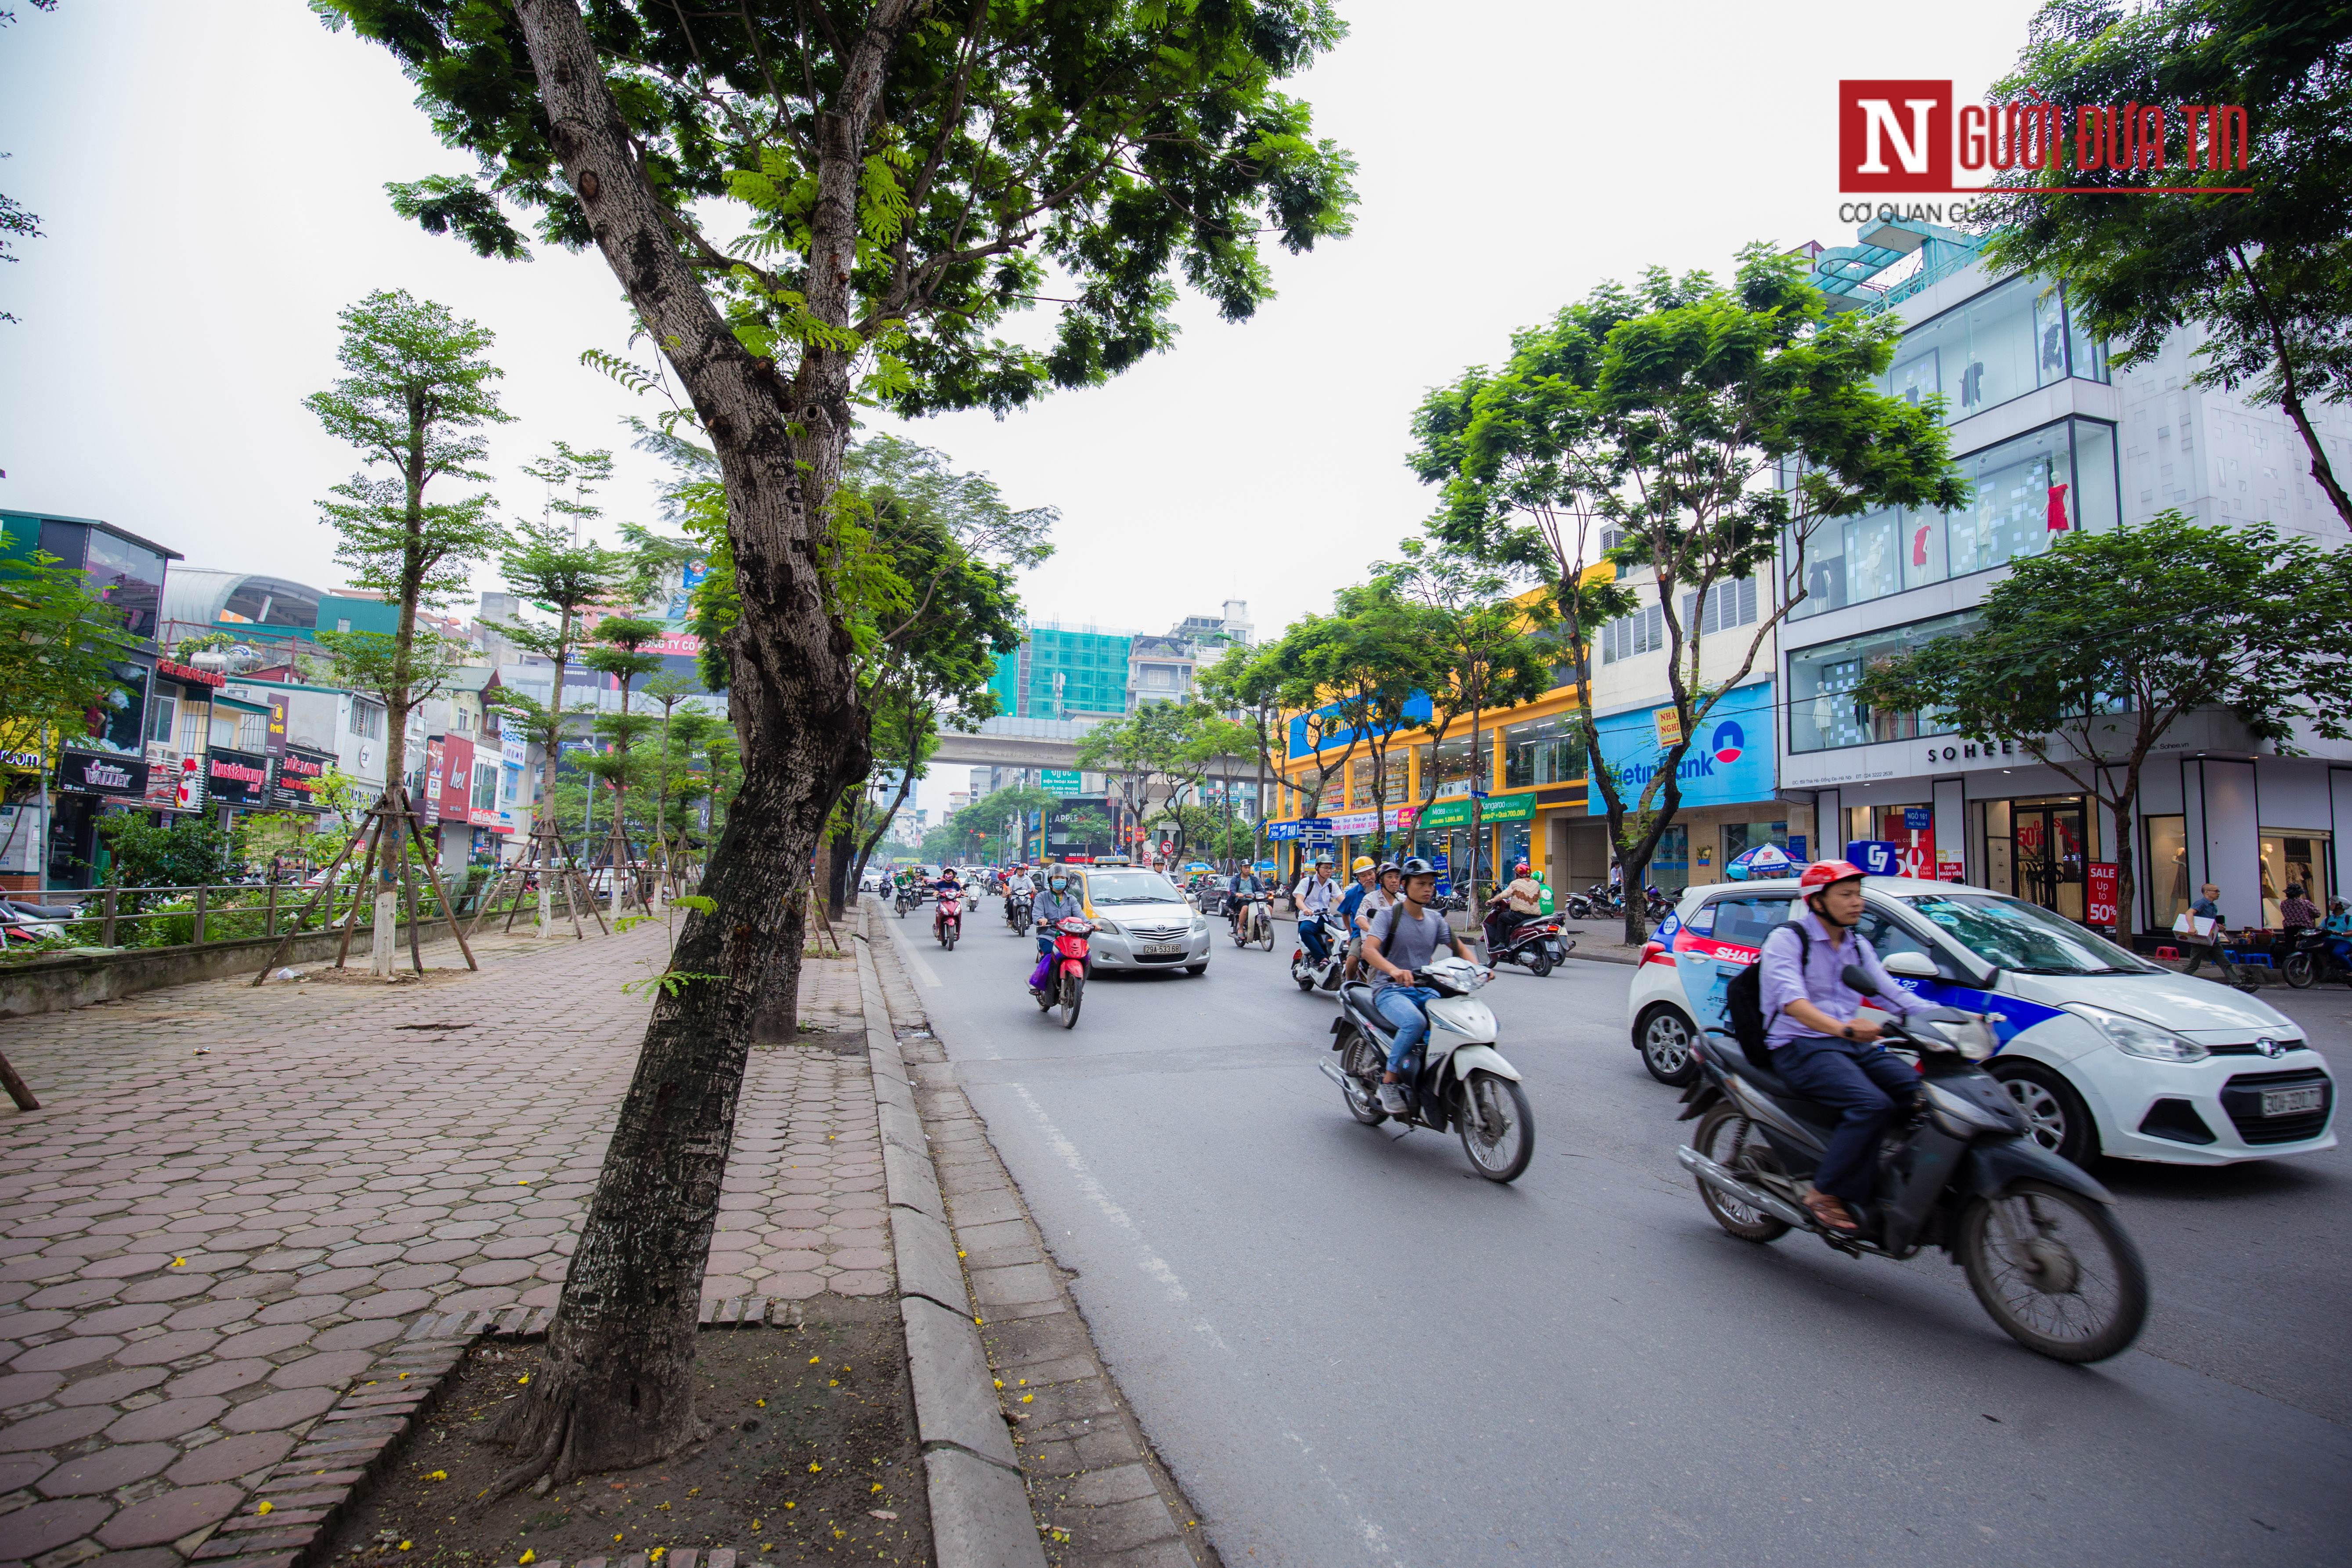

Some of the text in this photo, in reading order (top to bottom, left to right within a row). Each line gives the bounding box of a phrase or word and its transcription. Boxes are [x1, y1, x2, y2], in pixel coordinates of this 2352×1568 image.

[668, 640, 679, 650] TY
[682, 636, 695, 651] CỔ
[1660, 709, 1676, 722] NHÀ
[1661, 719, 1680, 733] NGHỈ
[1928, 740, 2012, 762] SOHEE
[211, 759, 265, 785] Russialuxury
[300, 761, 320, 777] LONG
[1481, 801, 1506, 811] Kangaroo
[2017, 820, 2044, 846] 50%
[354, 842, 365, 851] ALE
[1868, 845, 1888, 872] G7
[2090, 868, 2114, 878] SALE
[2097, 882, 2109, 890] Up
[2099, 892, 2107, 900] to
[2090, 903, 2117, 921] 50%
[1714, 947, 1761, 963] SHA
